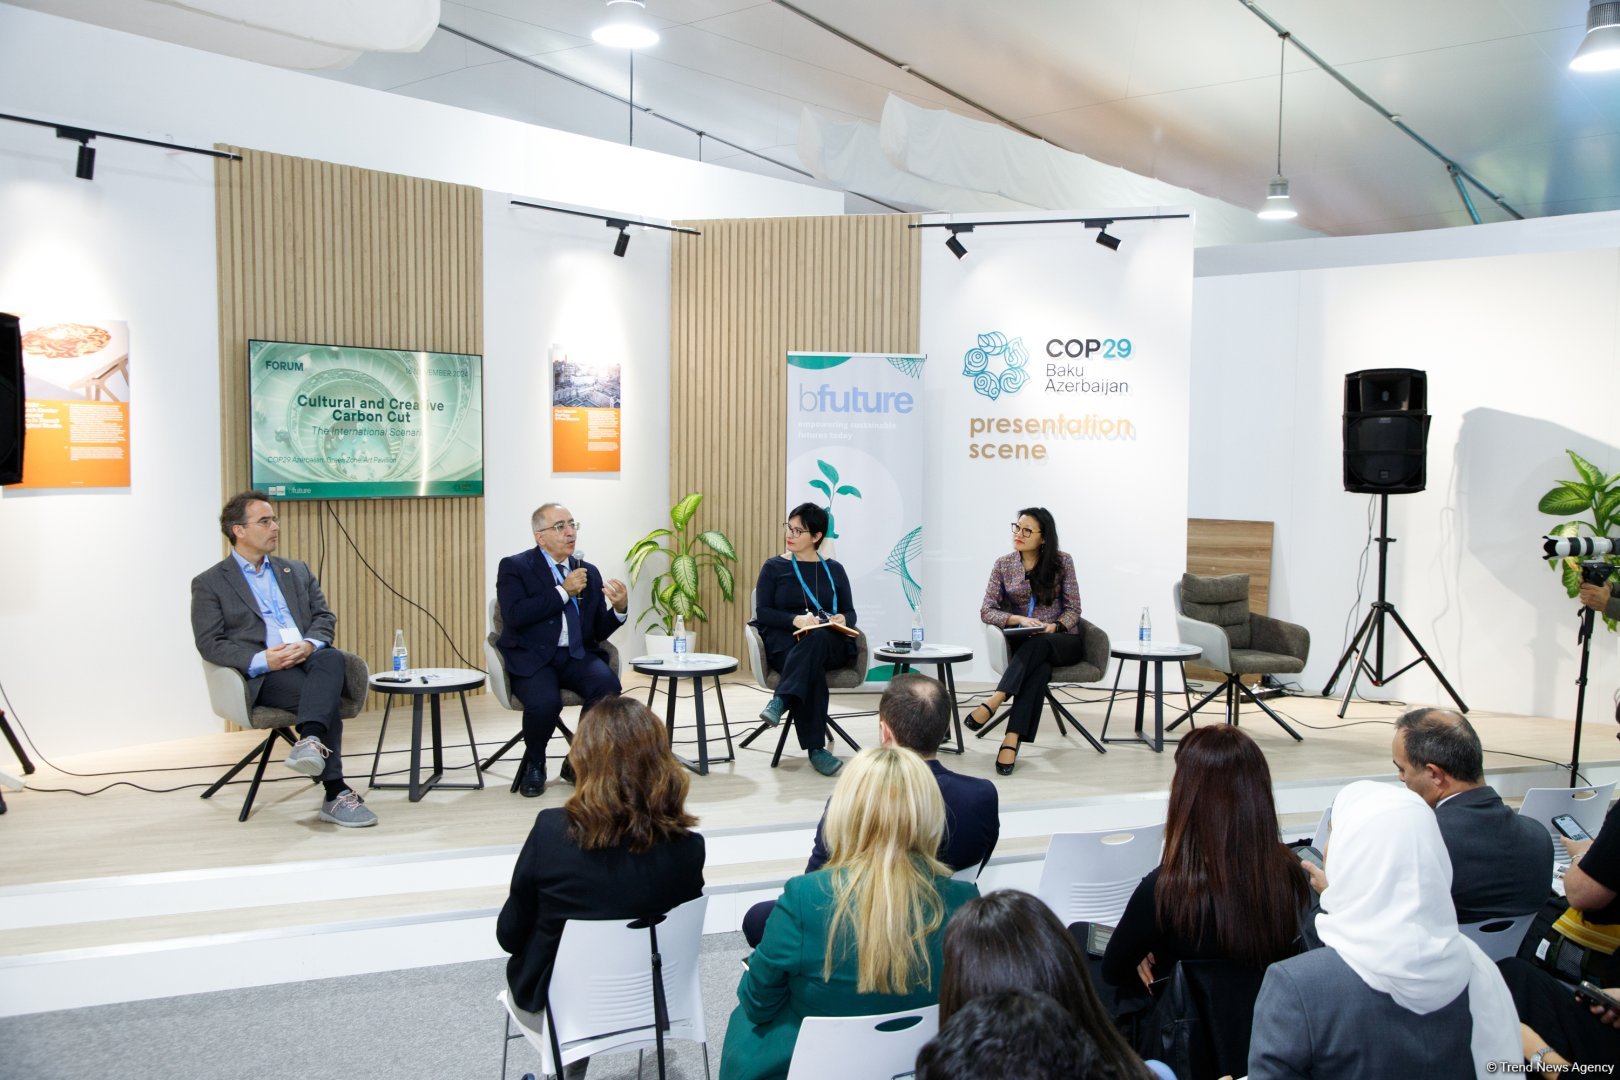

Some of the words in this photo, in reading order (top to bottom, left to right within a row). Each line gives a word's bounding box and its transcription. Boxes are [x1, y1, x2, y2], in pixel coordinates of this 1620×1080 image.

[1045, 338, 1132, 358] COP29
[265, 361, 304, 371] FORUM
[1046, 363, 1084, 377] Baku
[1045, 379, 1129, 395] Azerbaijan
[297, 395, 355, 408] Cultural
[360, 398, 384, 409] and
[389, 399, 444, 411] Creaive
[799, 383, 914, 413] bfuture
[332, 410, 382, 422] Carbon
[387, 411, 411, 422] Cut
[312, 426, 330, 435] The
[331, 427, 387, 436] International
[389, 428, 425, 436] Scenari
[970, 414, 1131, 438] presentation
[830, 431, 853, 440] today
[969, 443, 1047, 459] scene
